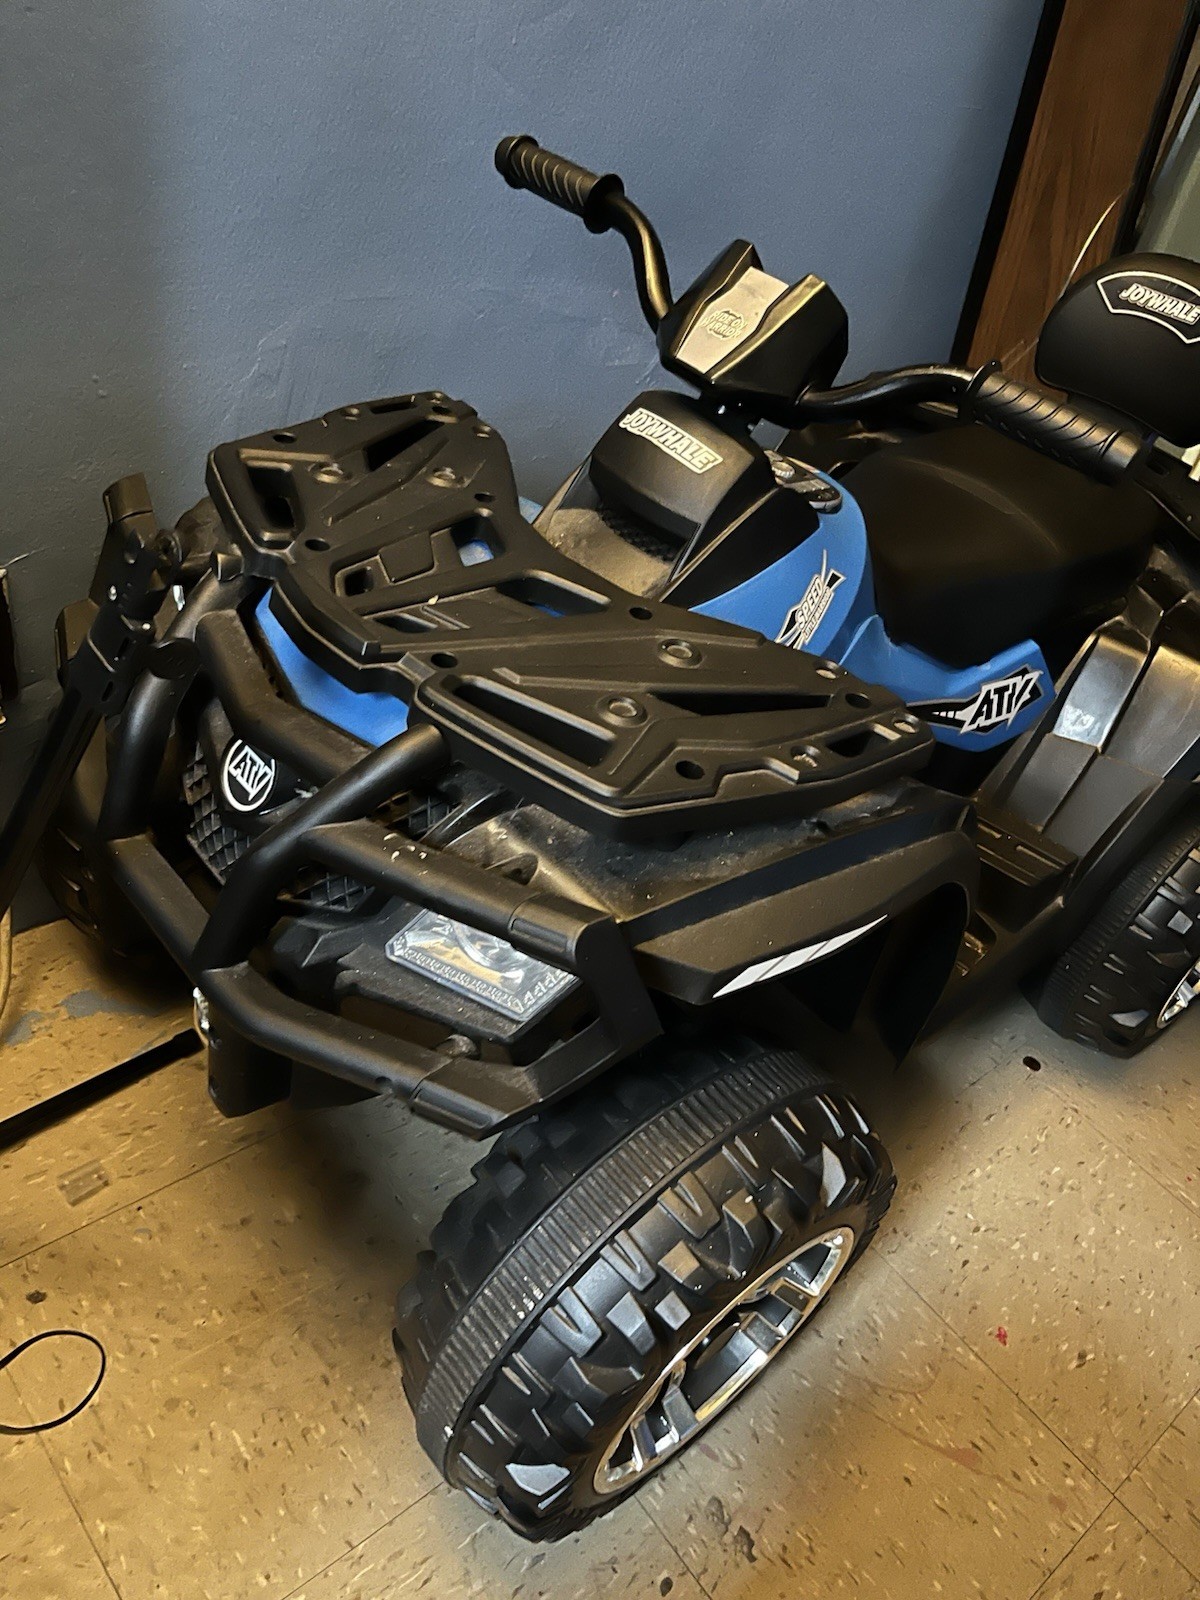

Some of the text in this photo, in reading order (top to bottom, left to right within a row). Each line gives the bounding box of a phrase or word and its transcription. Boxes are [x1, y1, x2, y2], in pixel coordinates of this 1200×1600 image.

[1119, 284, 1200, 324] JOYWHALE
[620, 409, 722, 473] JOYWHALE
[797, 576, 824, 629] SPEED
[962, 671, 1041, 732] ATV
[229, 746, 272, 800] ATV
